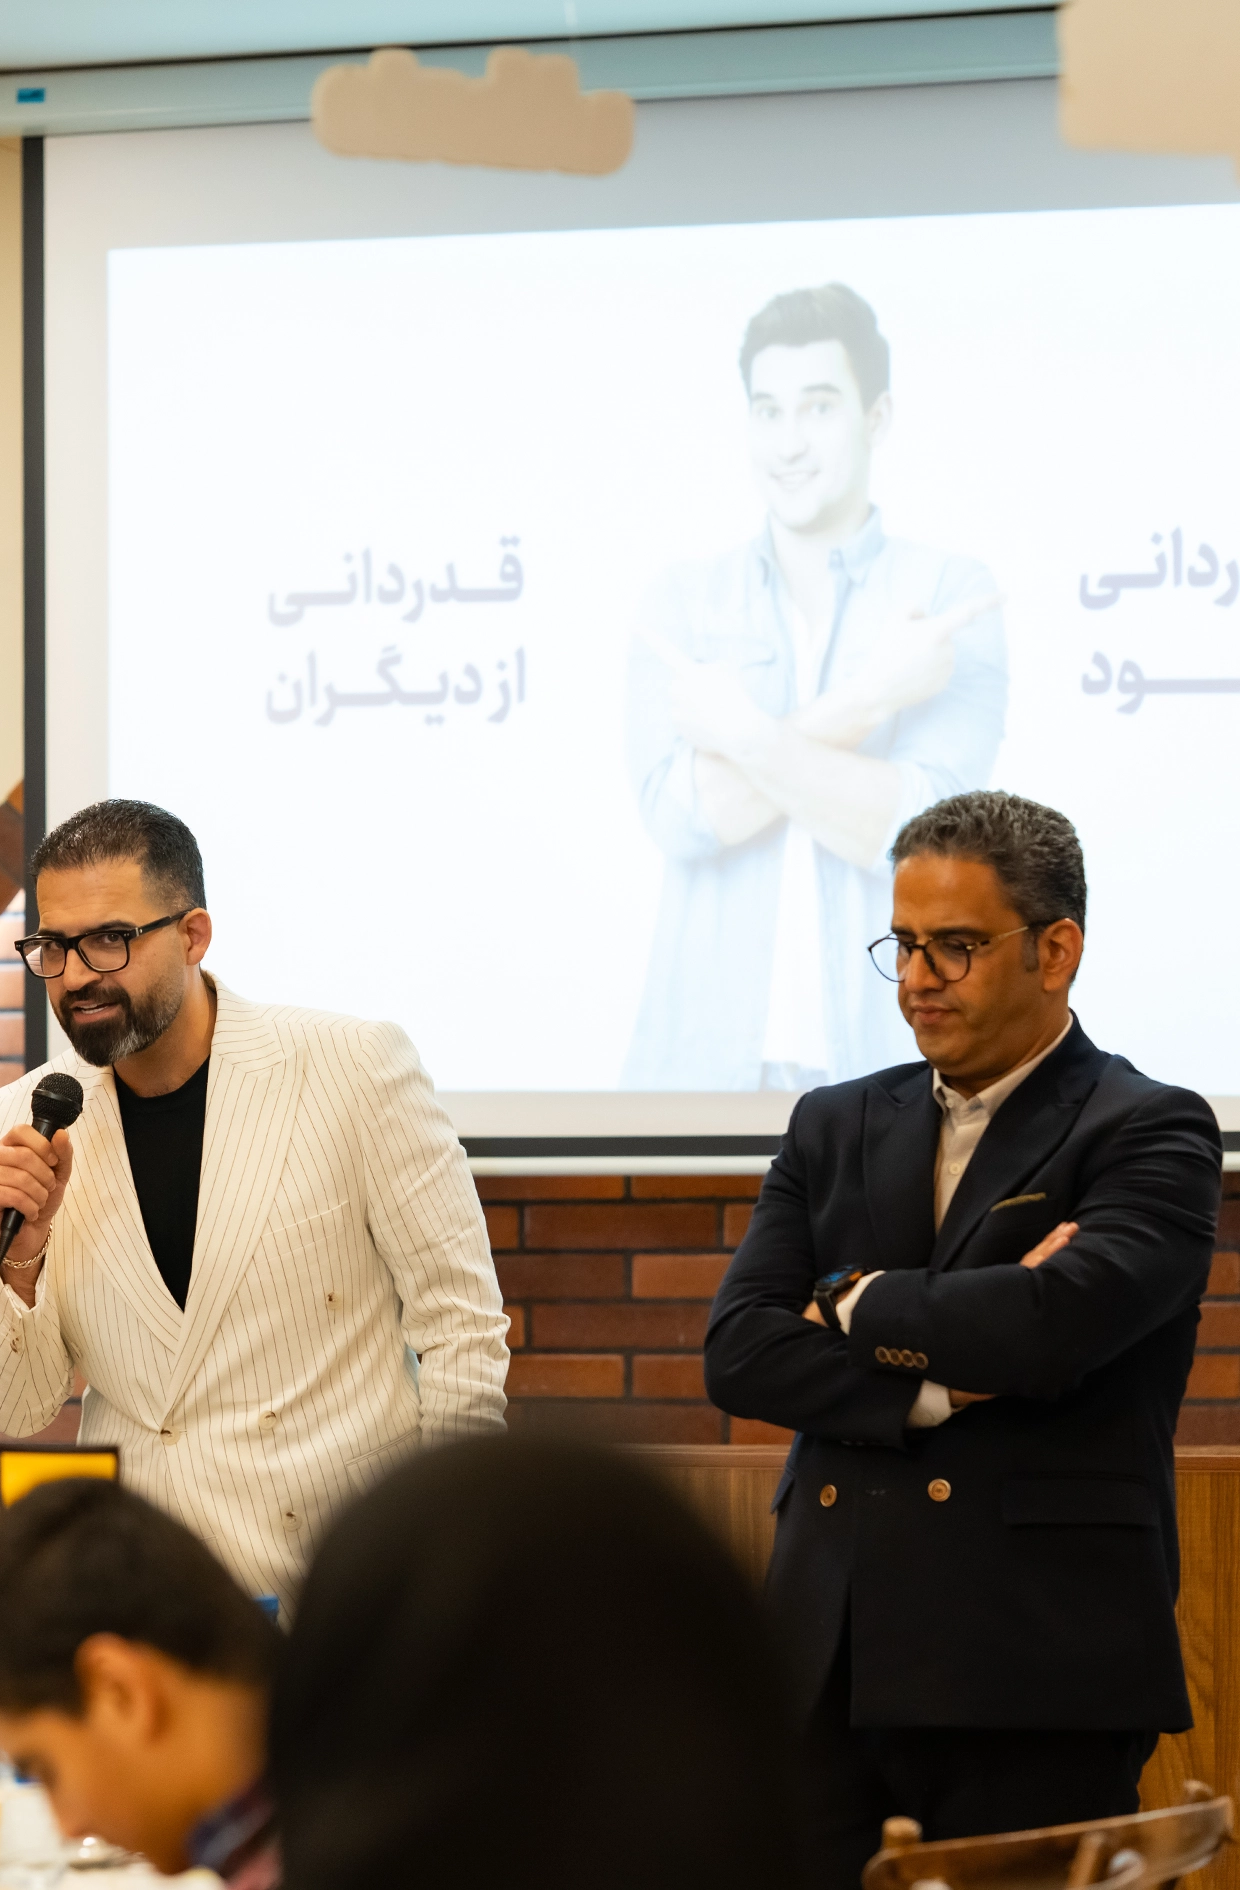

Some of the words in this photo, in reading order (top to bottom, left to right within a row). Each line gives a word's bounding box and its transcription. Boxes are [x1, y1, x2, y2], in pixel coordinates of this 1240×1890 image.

[266, 534, 525, 629] قدردانی
[1078, 526, 1240, 611] ردانی
[1080, 650, 1240, 715] ود
